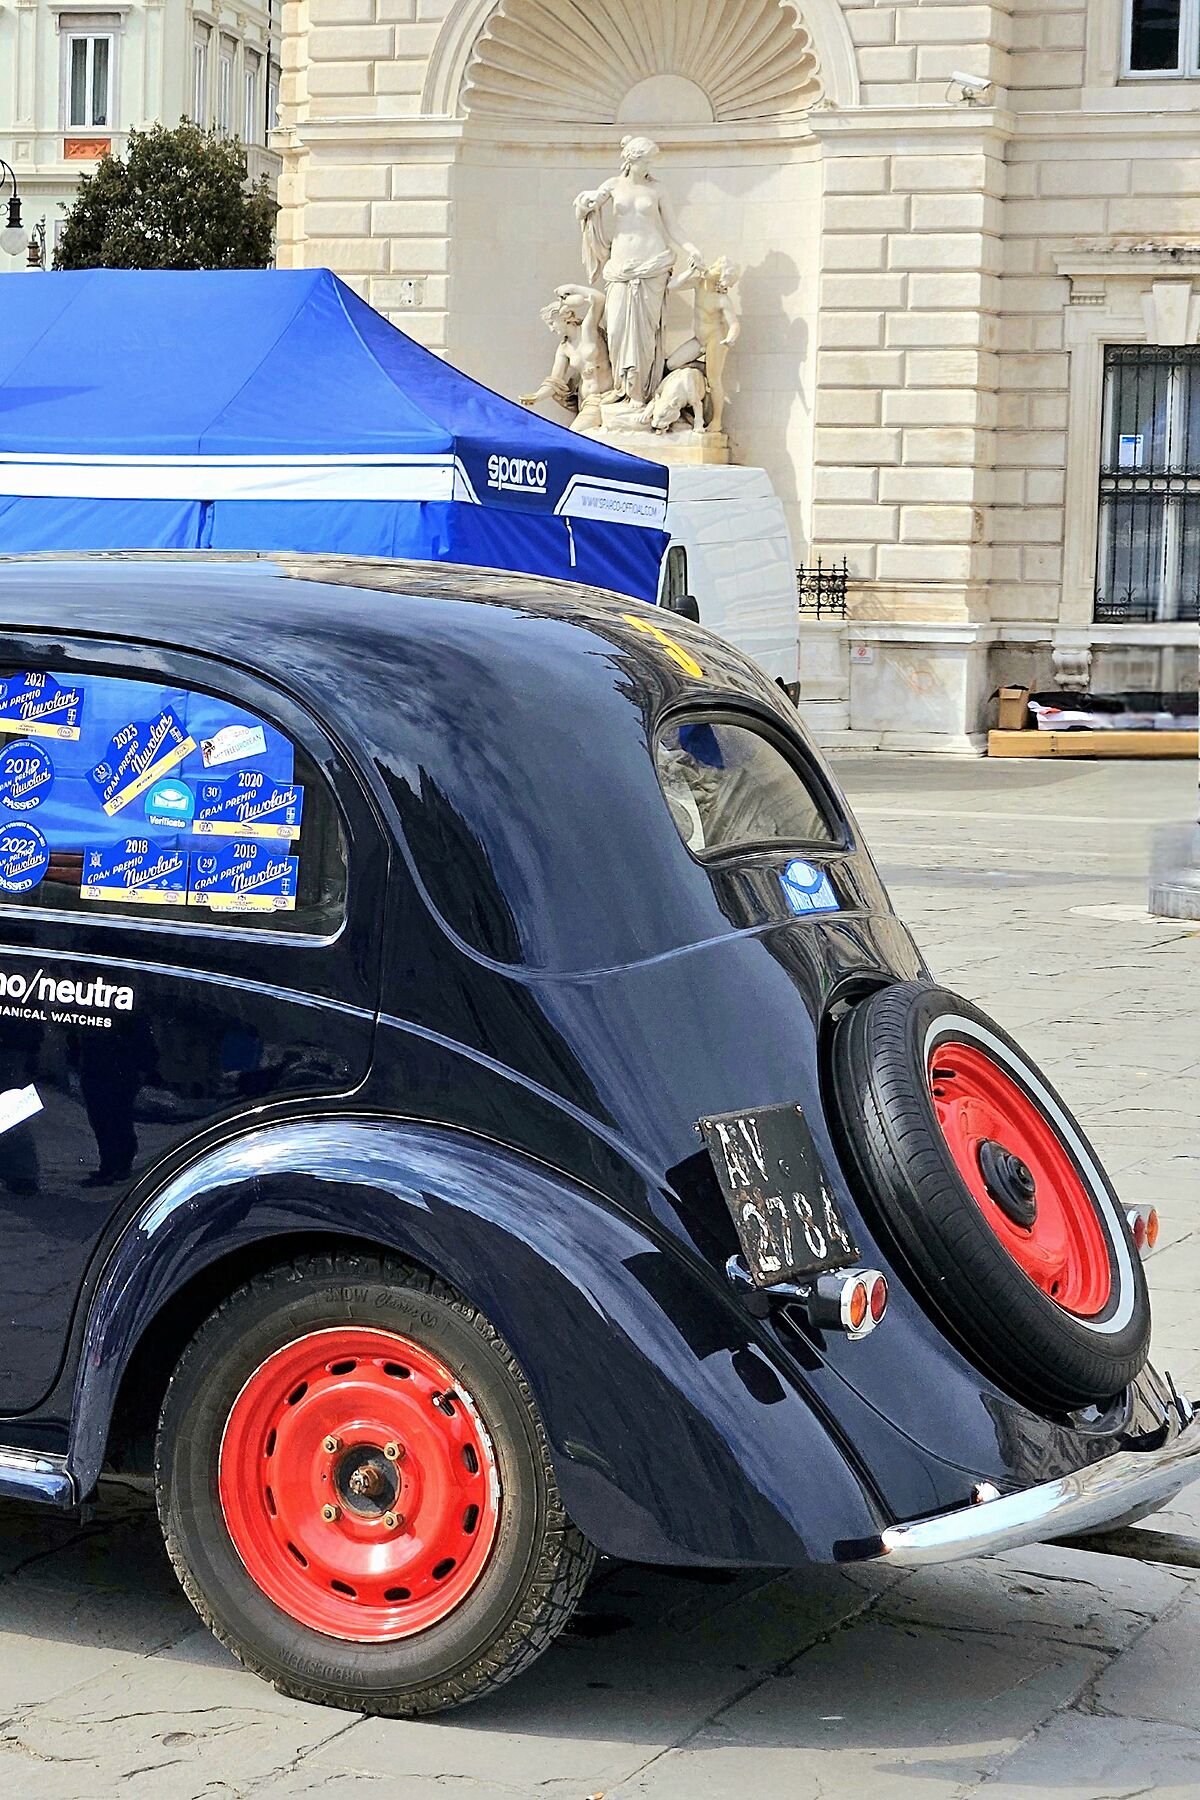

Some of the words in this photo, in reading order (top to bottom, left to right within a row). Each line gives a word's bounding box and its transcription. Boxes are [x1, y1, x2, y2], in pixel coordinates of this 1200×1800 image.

[487, 454, 548, 490] sparco
[24, 672, 46, 688] 2021
[9, 689, 41, 707] PREMIO
[19, 688, 79, 721] Nuvolari
[113, 723, 138, 749] 2023
[130, 711, 173, 775] Nuvolari
[4, 758, 41, 774] 2019
[103, 772, 120, 800] GRAN
[118, 740, 140, 776] PREMIO
[10, 768, 52, 798] Nuvolari
[238, 773, 263, 788] 2020
[2, 796, 40, 811] PASSED
[200, 803, 223, 819] GRAN
[224, 789, 257, 810] PREMIO
[236, 786, 297, 823] Nuvolari
[0, 837, 37, 854] 2023
[125, 839, 148, 854] 2018
[233, 843, 257, 859] 2019
[3, 851, 46, 878] Nuvolari
[87, 869, 110, 884] GRAN
[112, 855, 143, 875] PREMIO
[123, 852, 183, 889] Nuvolari
[194, 874, 218, 890] GRAN
[220, 860, 252, 879] PREMIO
[231, 857, 293, 893] Nuvolari
[51, 1011, 112, 1028] WATCHES
